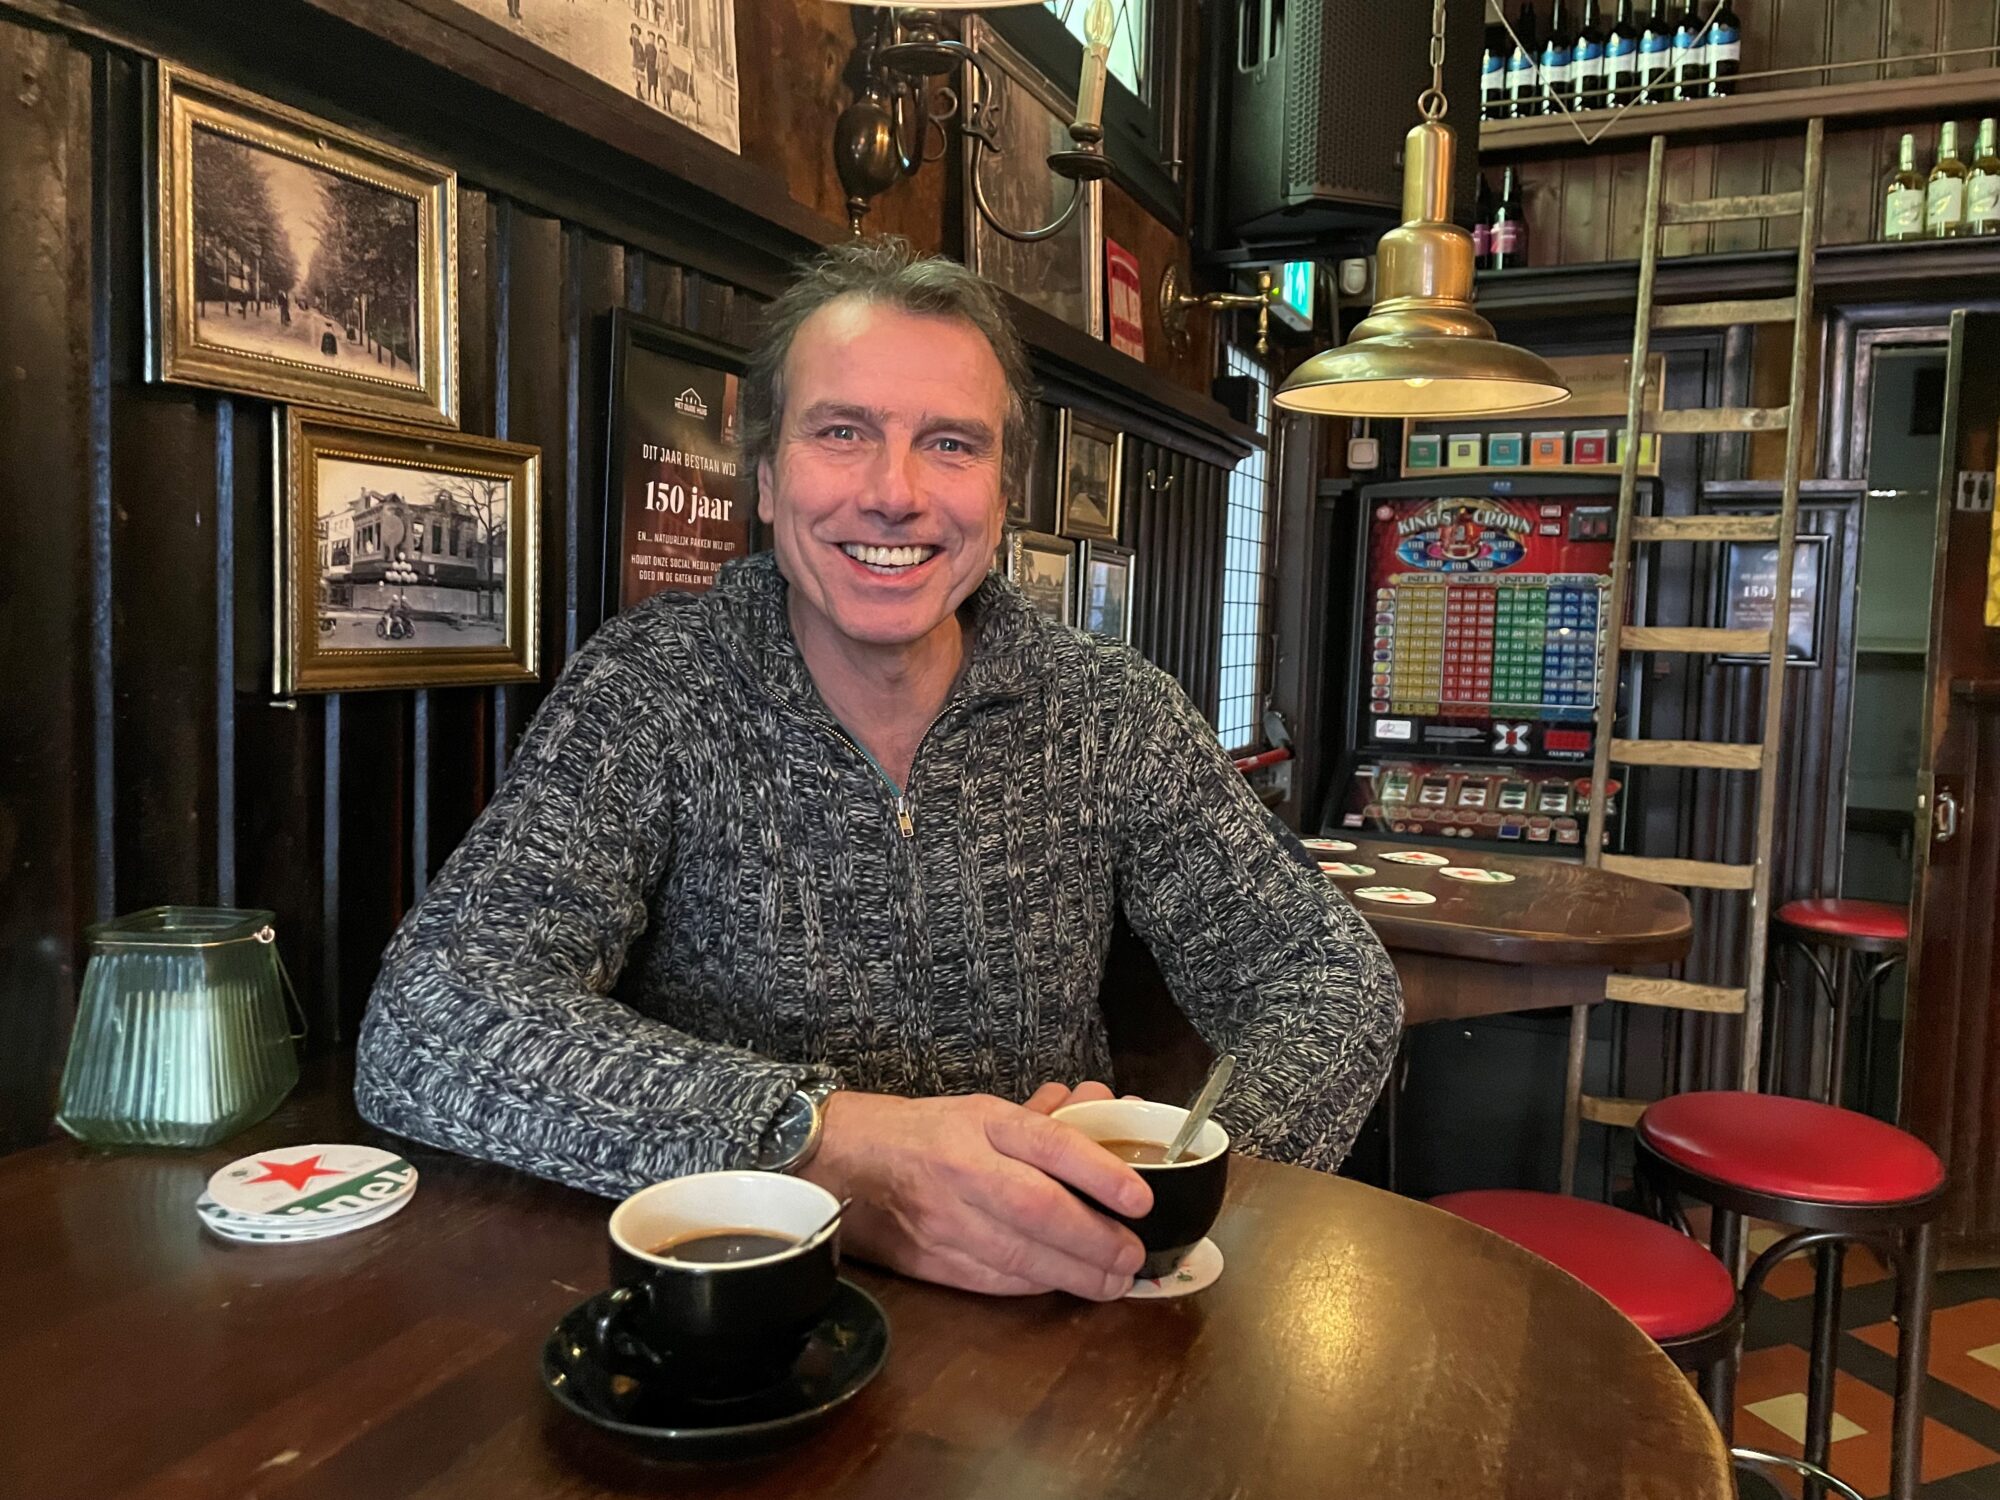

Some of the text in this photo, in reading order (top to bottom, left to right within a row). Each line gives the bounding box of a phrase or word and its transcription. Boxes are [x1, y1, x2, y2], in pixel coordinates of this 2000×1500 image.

[642, 443, 736, 477] DIT JAAR BESTAAN WIJ
[645, 481, 733, 524] 150 jaar
[1473, 509, 1532, 535] CROWN
[654, 533, 689, 546] NATUURLIJK
[690, 537, 711, 548] PAKKEN
[712, 540, 723, 550] WIJ
[631, 554, 652, 566] HOUDT
[653, 556, 668, 568] ONZE
[669, 558, 690, 569] SOCIAL
[692, 561, 709, 571] MEDIA
[639, 570, 656, 581] GOED
[657, 571, 664, 581] IN
[665, 572, 673, 582] DE
[674, 573, 693, 584] GATEN
[693, 575, 701, 584] EN
[1743, 585, 1768, 597] 150
